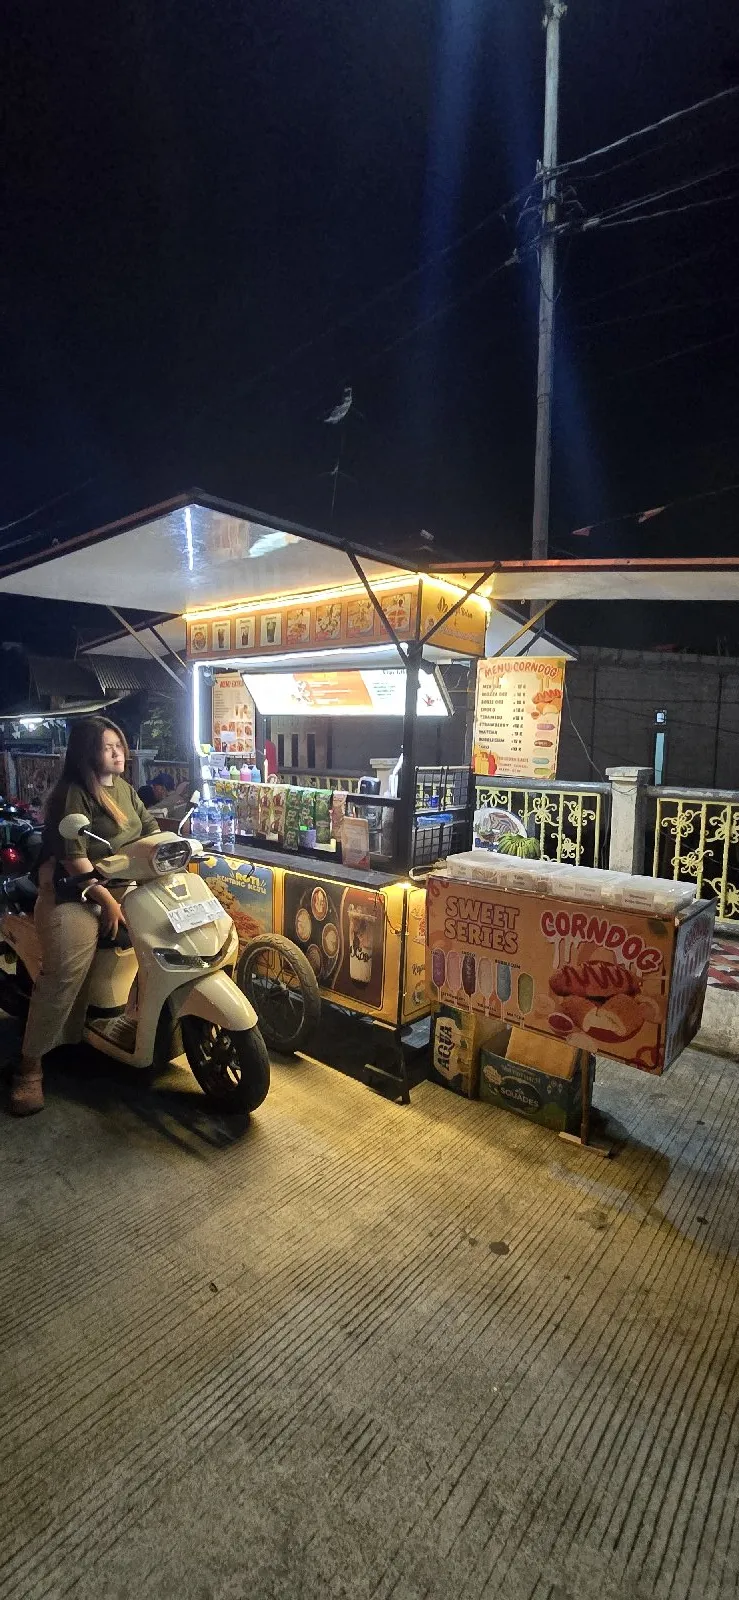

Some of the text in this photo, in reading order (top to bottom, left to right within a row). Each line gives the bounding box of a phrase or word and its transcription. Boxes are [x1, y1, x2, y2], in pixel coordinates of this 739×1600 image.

[484, 661, 558, 678] MENU CORNDOG
[445, 895, 520, 930] SWEET
[444, 918, 519, 954] SERIES
[540, 911, 662, 972] CORNDOG
[437, 1025, 455, 1071] AQUA
[500, 1087, 539, 1107] SQUADES
